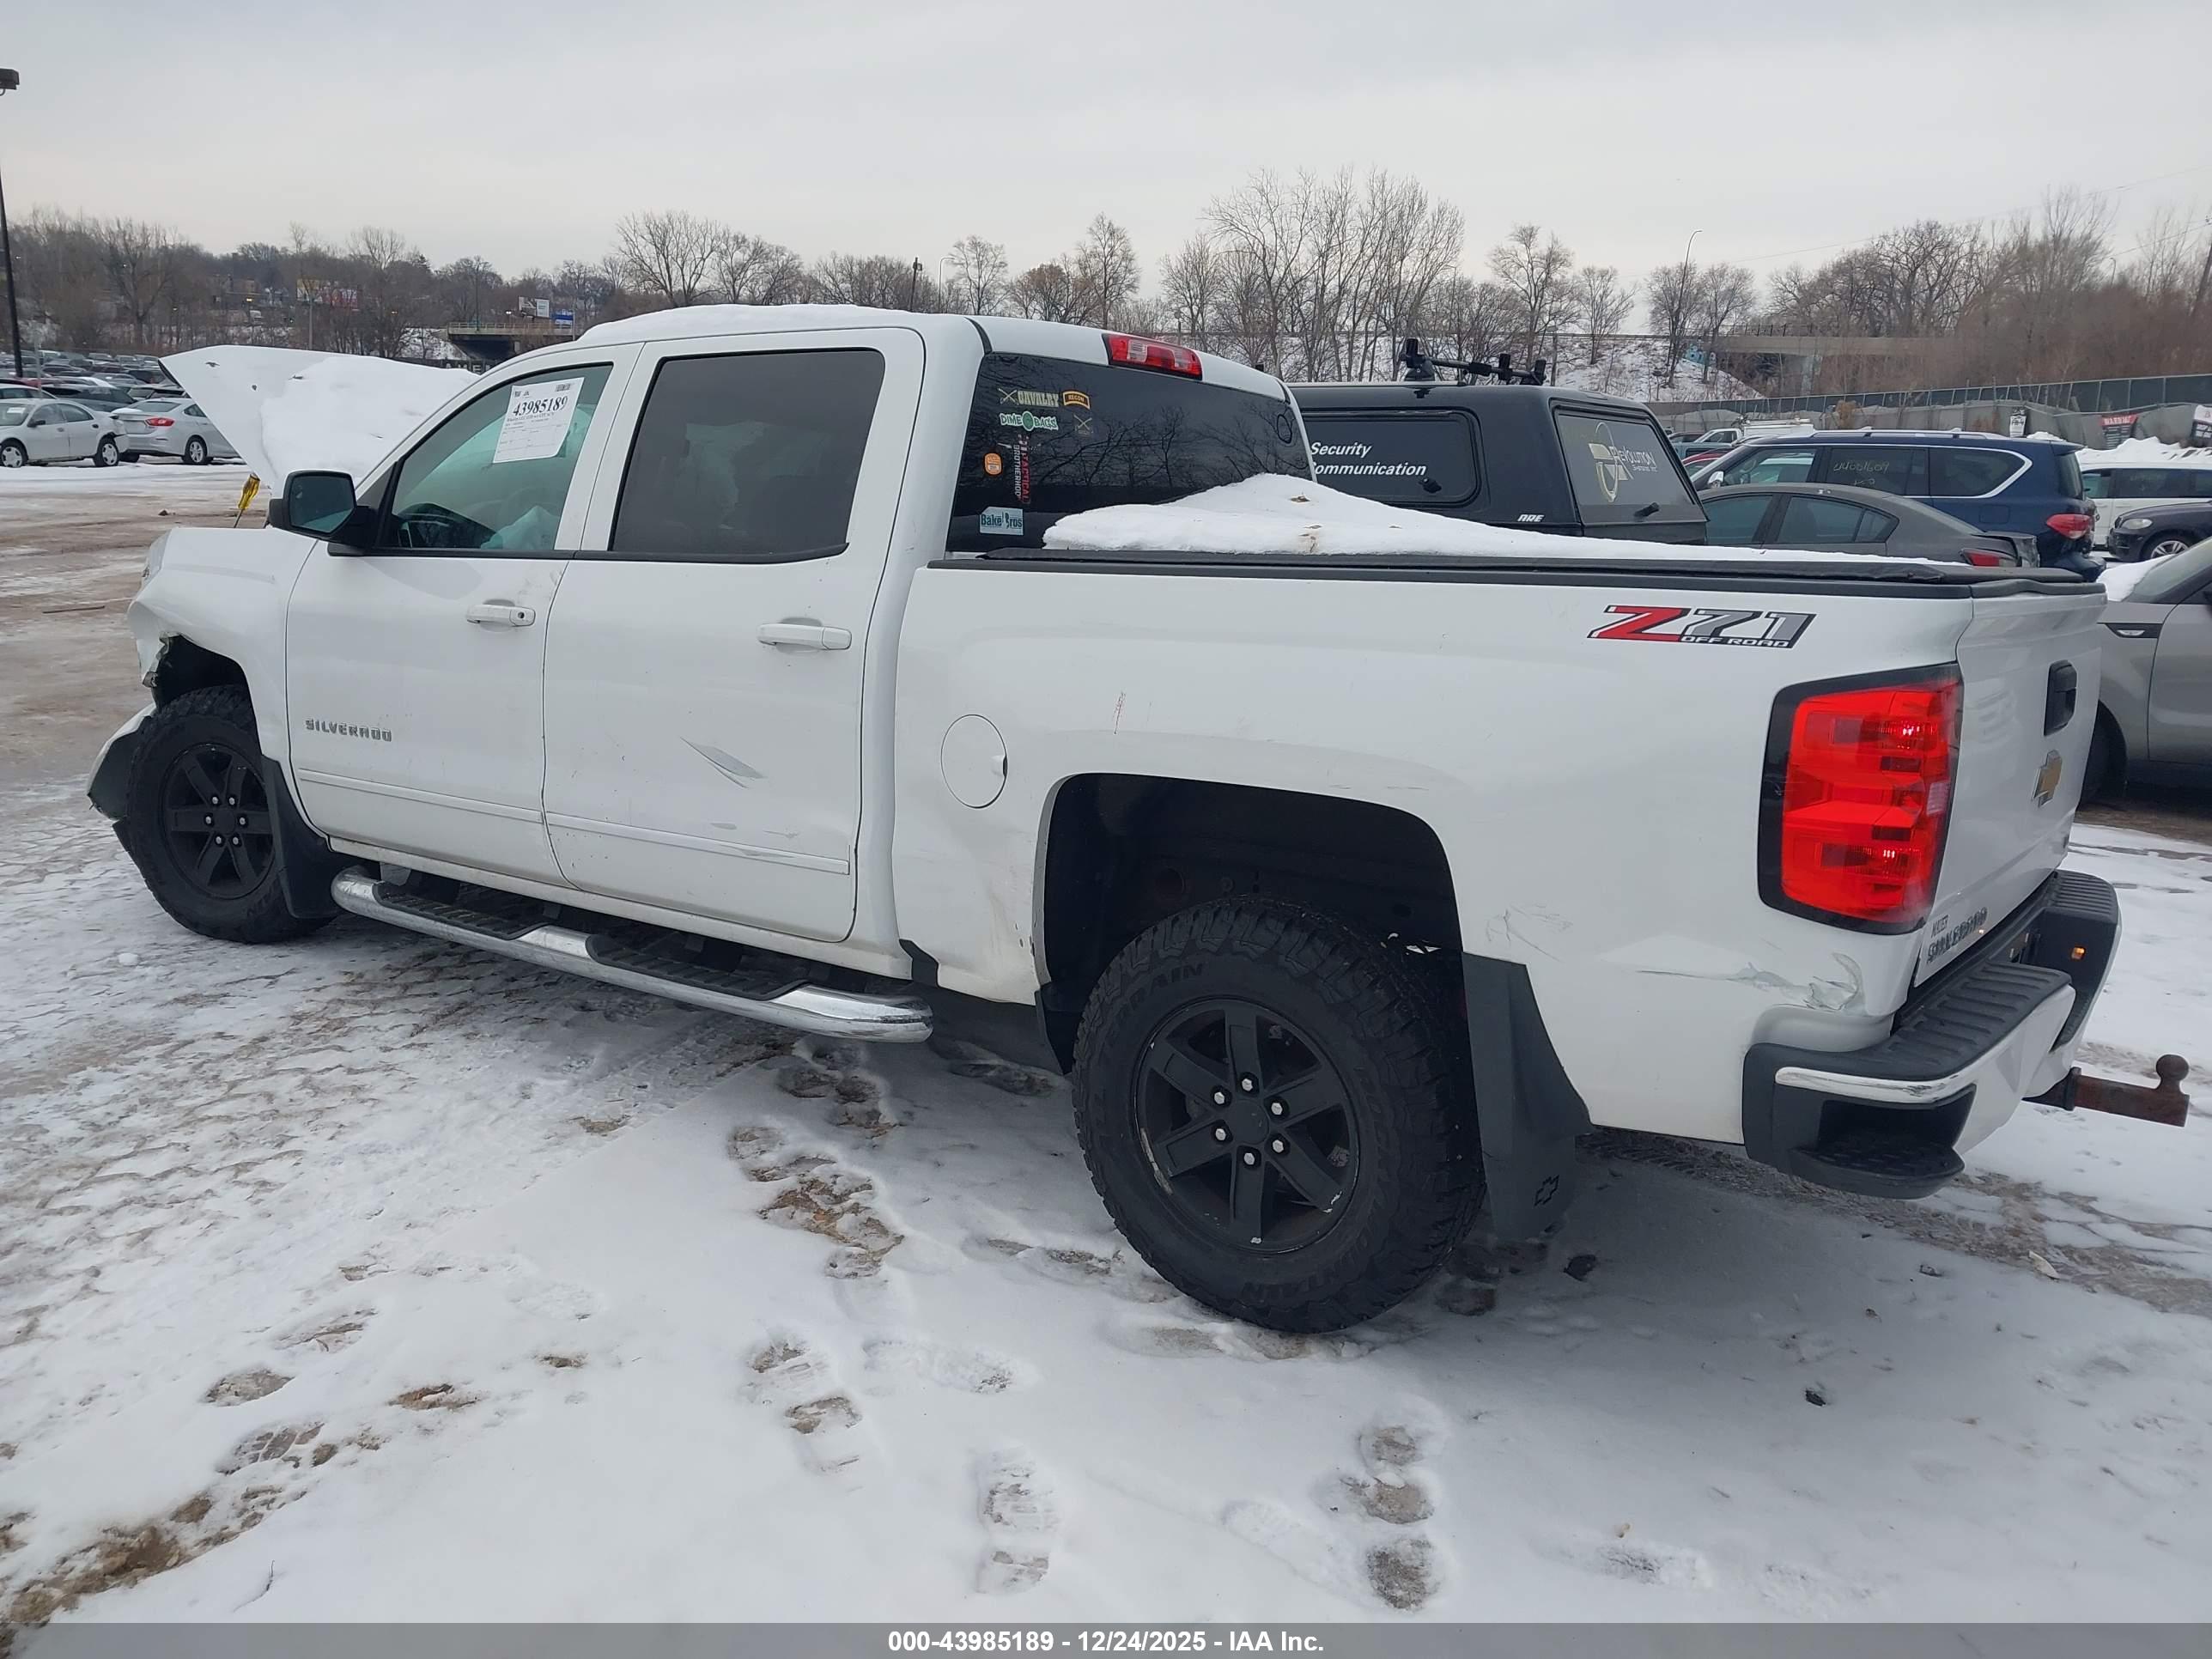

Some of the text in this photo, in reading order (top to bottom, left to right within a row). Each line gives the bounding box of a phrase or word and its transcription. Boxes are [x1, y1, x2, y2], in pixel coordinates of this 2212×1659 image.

[513, 396, 568, 416] 43985189
[1018, 391, 1085, 407] CAVALRY RECON
[1000, 413, 1059, 430] DIME BAGS
[1310, 441, 1373, 458] Security
[981, 512, 1023, 529] Bake Bros
[1516, 514, 1545, 523] ARE
[1587, 604, 1817, 648] Z71
[1680, 635, 1790, 648] OFF ROAD
[305, 718, 392, 743] SILVERADO
